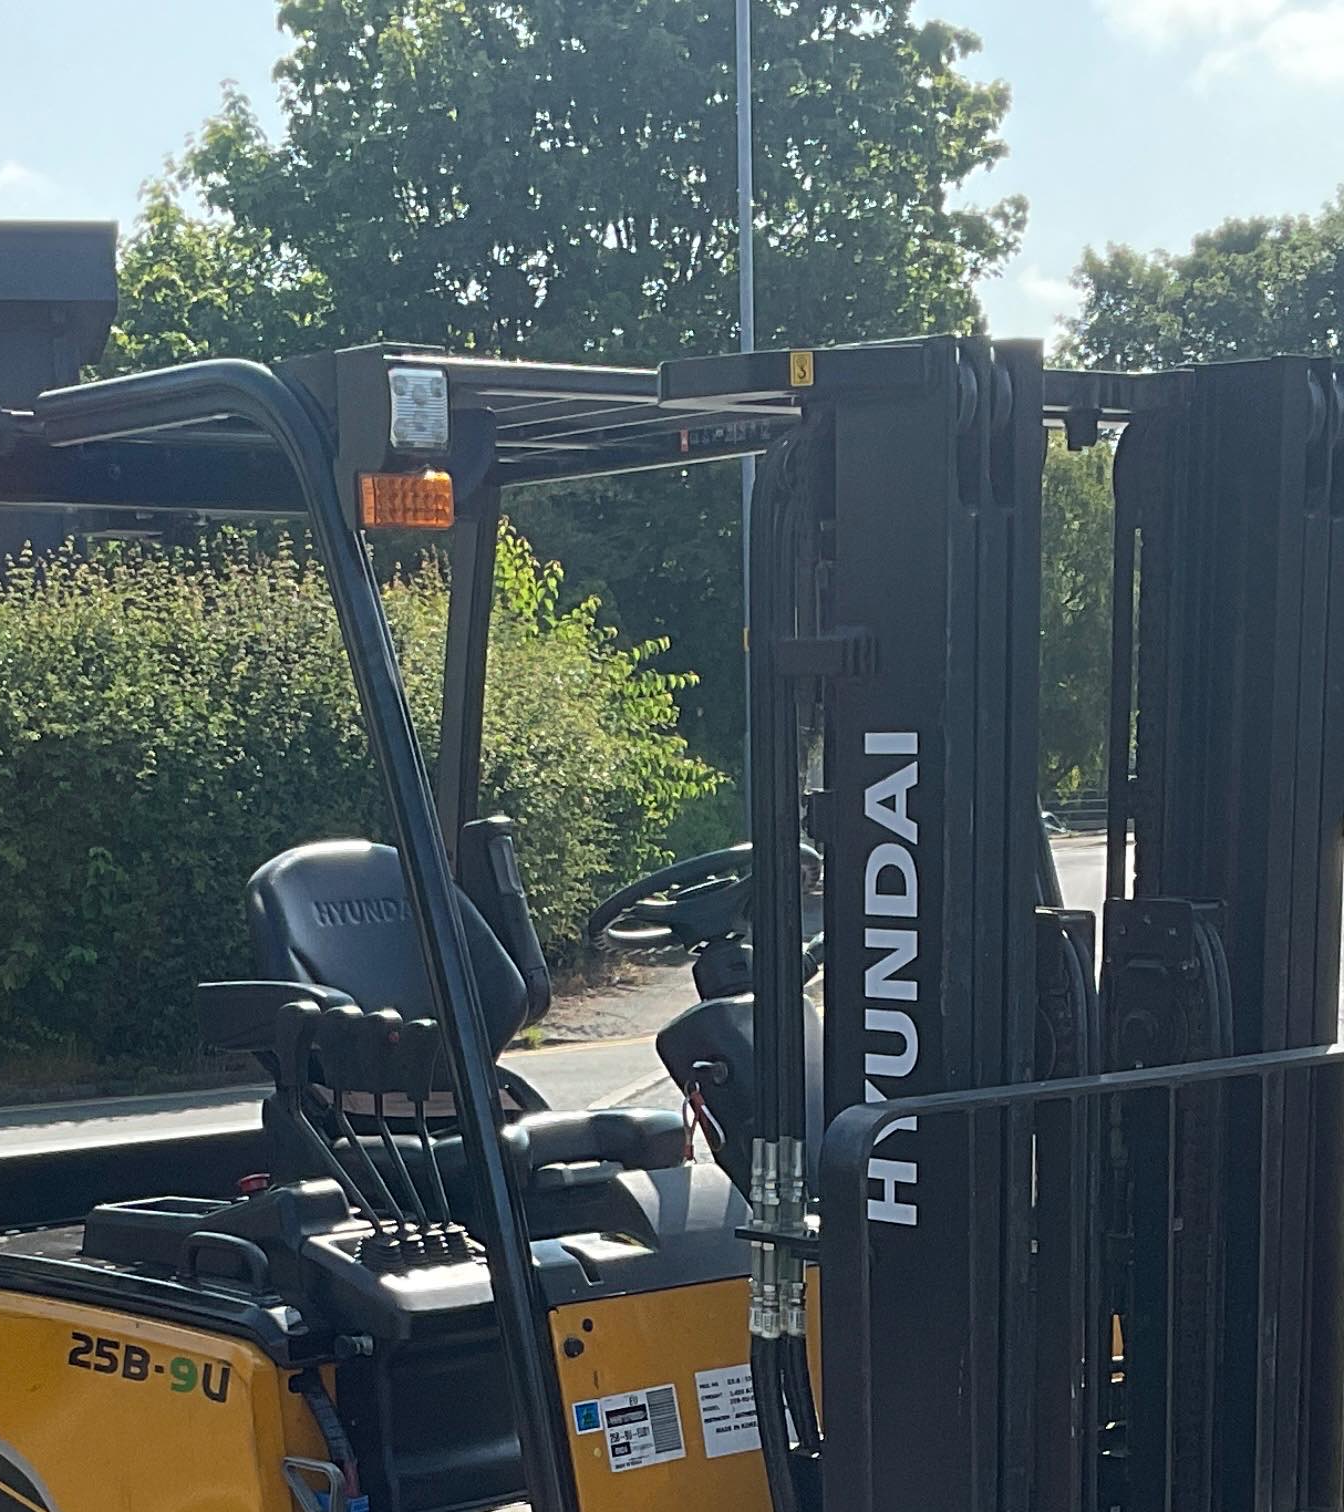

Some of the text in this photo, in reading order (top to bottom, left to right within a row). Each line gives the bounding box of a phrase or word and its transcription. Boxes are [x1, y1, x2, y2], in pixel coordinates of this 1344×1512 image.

[311, 898, 415, 926] HYUND
[864, 731, 919, 1227] HYUNDAI
[68, 1331, 231, 1404] 25B-9U
